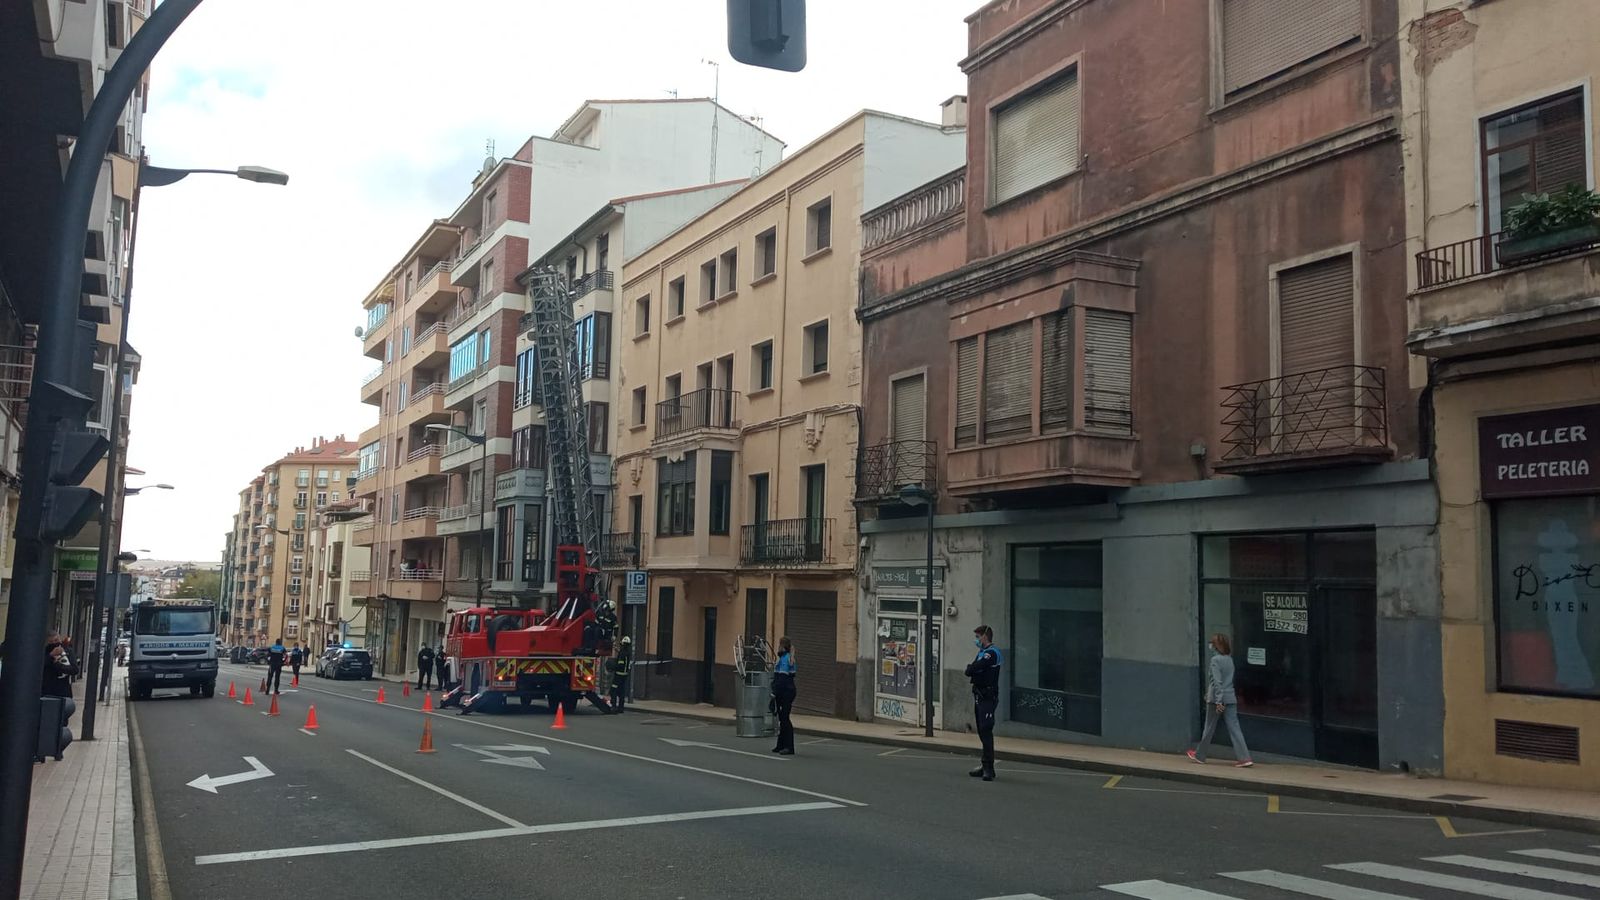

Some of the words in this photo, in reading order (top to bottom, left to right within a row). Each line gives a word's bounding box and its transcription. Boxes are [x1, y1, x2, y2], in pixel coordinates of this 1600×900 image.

[1496, 425, 1588, 449] TALLER
[1497, 459, 1590, 480] PELETERIA
[636, 574, 644, 584] P
[1265, 595, 1275, 608] SE
[1276, 596, 1307, 609] ALQUILA
[1532, 601, 1588, 612] DIXEN
